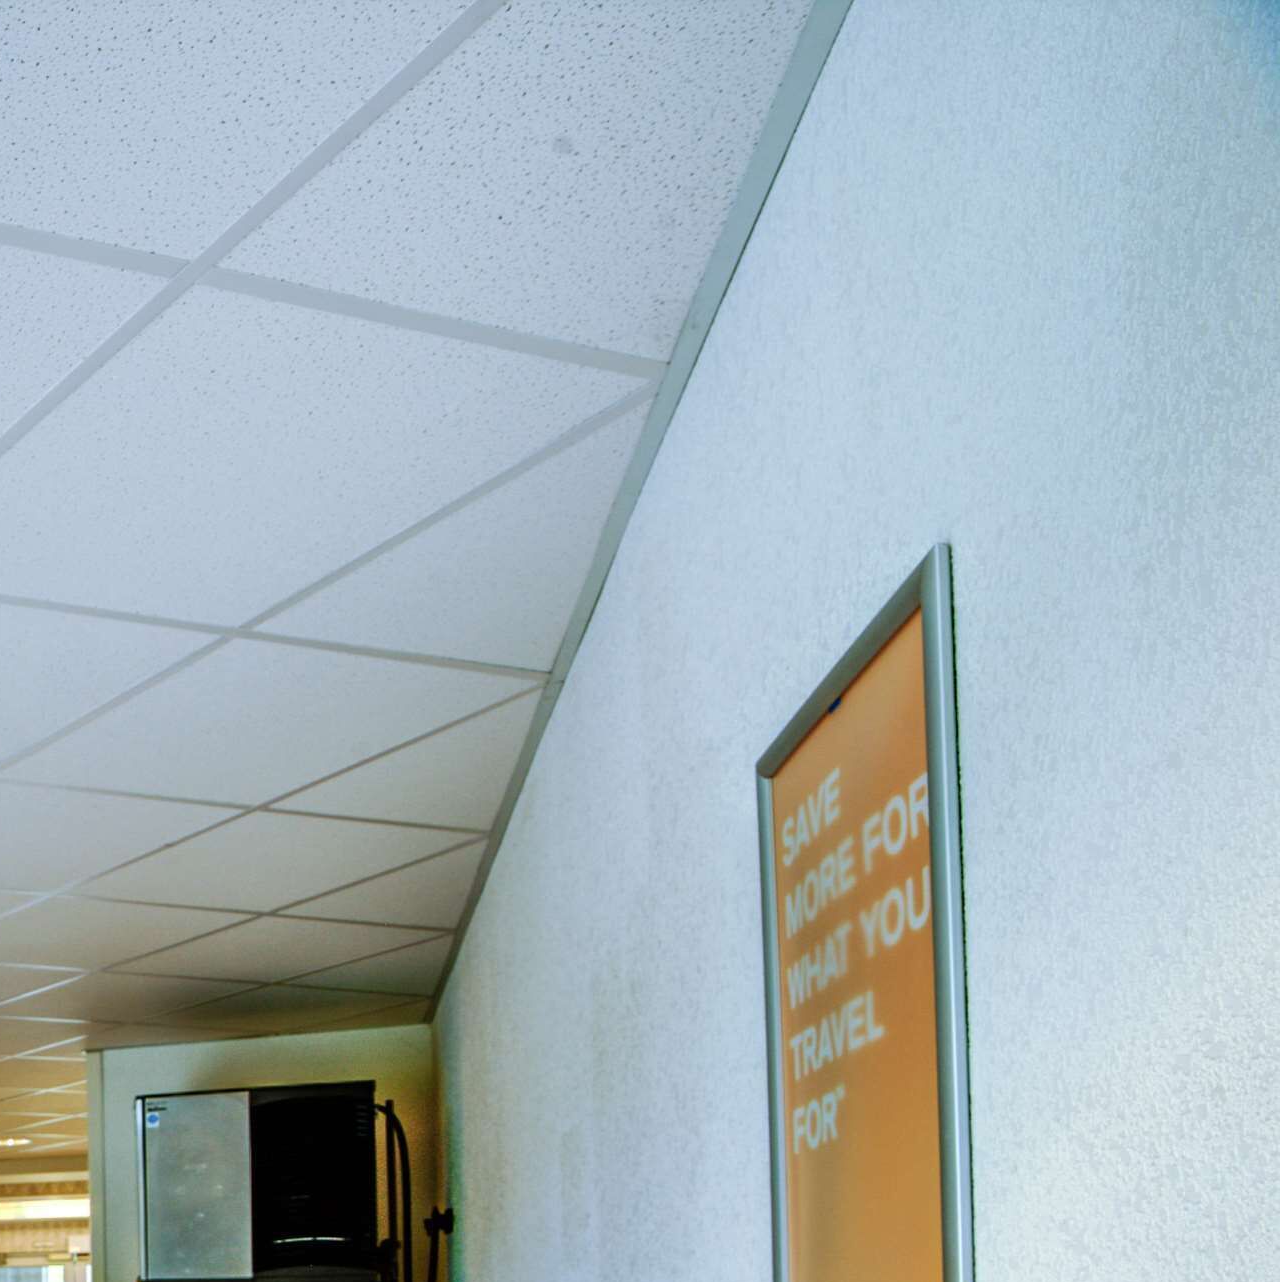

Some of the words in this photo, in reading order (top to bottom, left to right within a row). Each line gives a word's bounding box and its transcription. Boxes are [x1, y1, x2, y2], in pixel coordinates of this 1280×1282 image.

[782, 768, 841, 867] SAVE
[784, 837, 856, 940] MORE
[862, 772, 930, 873] FOR
[787, 923, 852, 1010] WHAT
[859, 866, 931, 959] YOU
[790, 991, 885, 1082] TRAVEL
